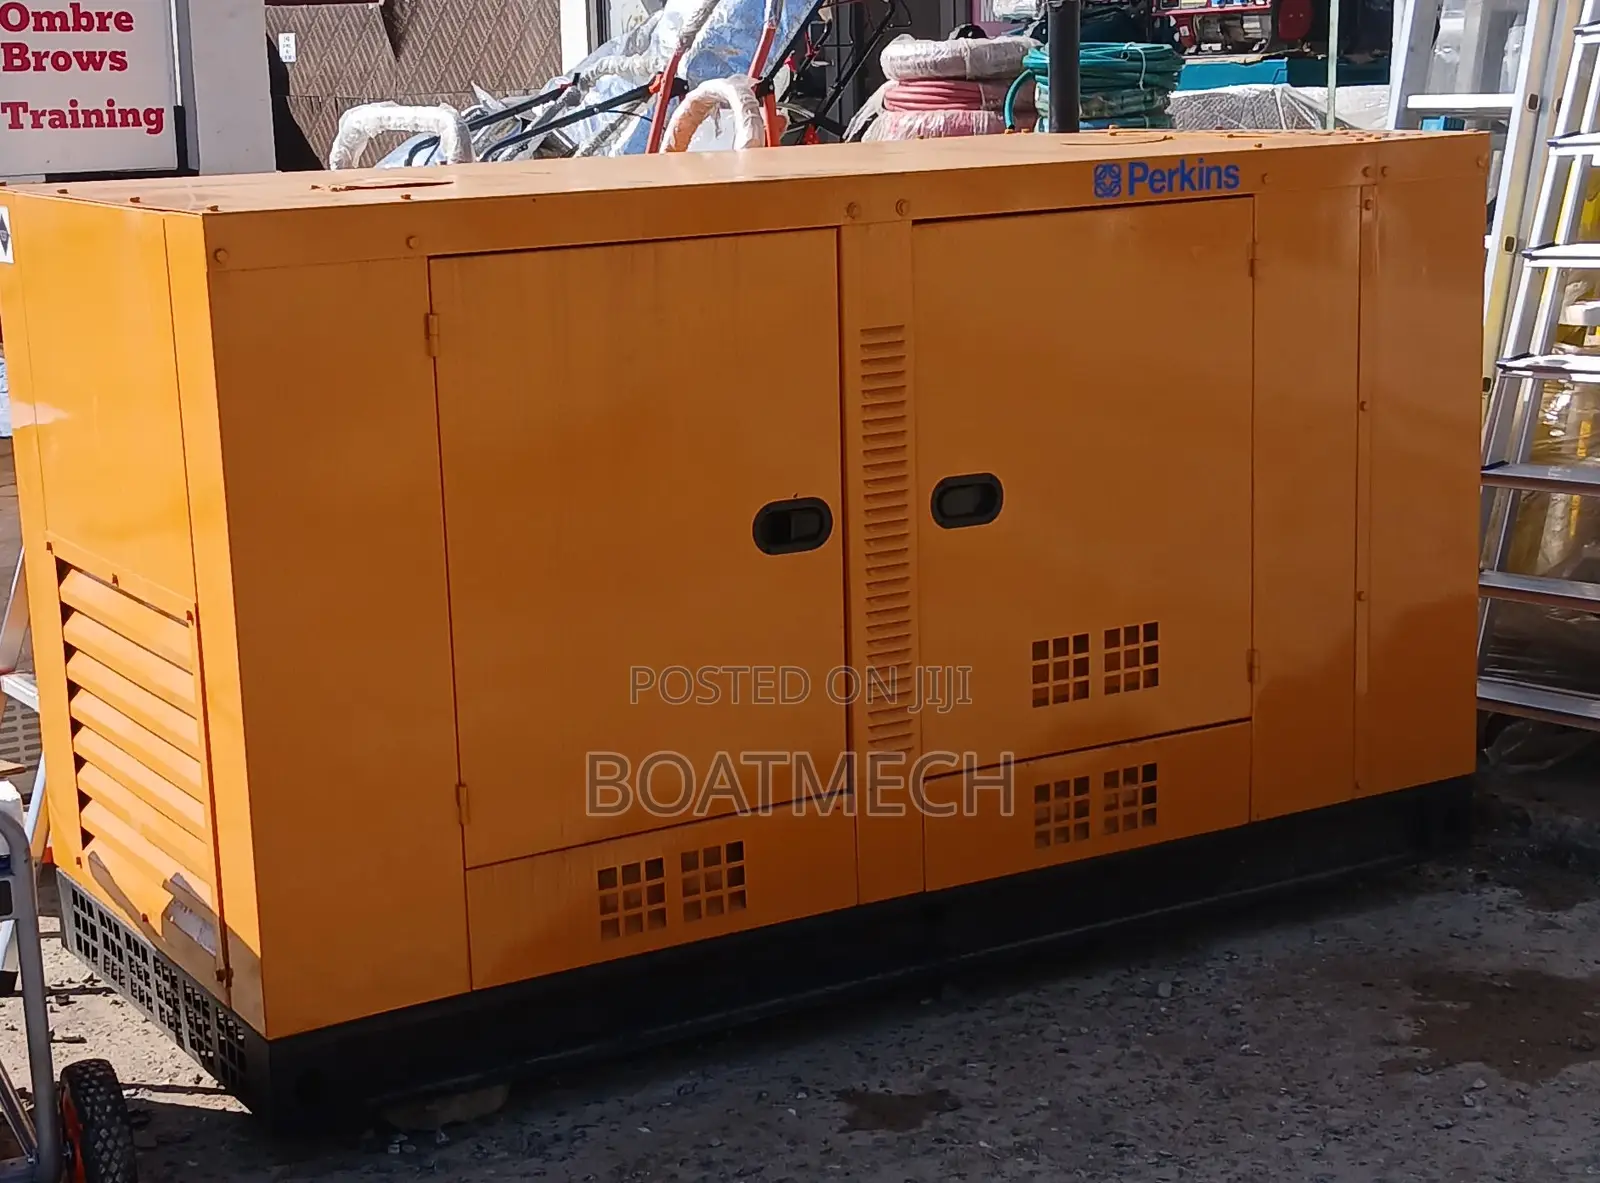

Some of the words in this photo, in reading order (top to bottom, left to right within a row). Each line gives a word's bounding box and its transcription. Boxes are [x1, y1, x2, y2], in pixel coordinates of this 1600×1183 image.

[0, 2, 134, 32] Ombre
[1, 42, 128, 72] Brows
[1, 98, 164, 134] Training
[1128, 158, 1240, 196] Perkins
